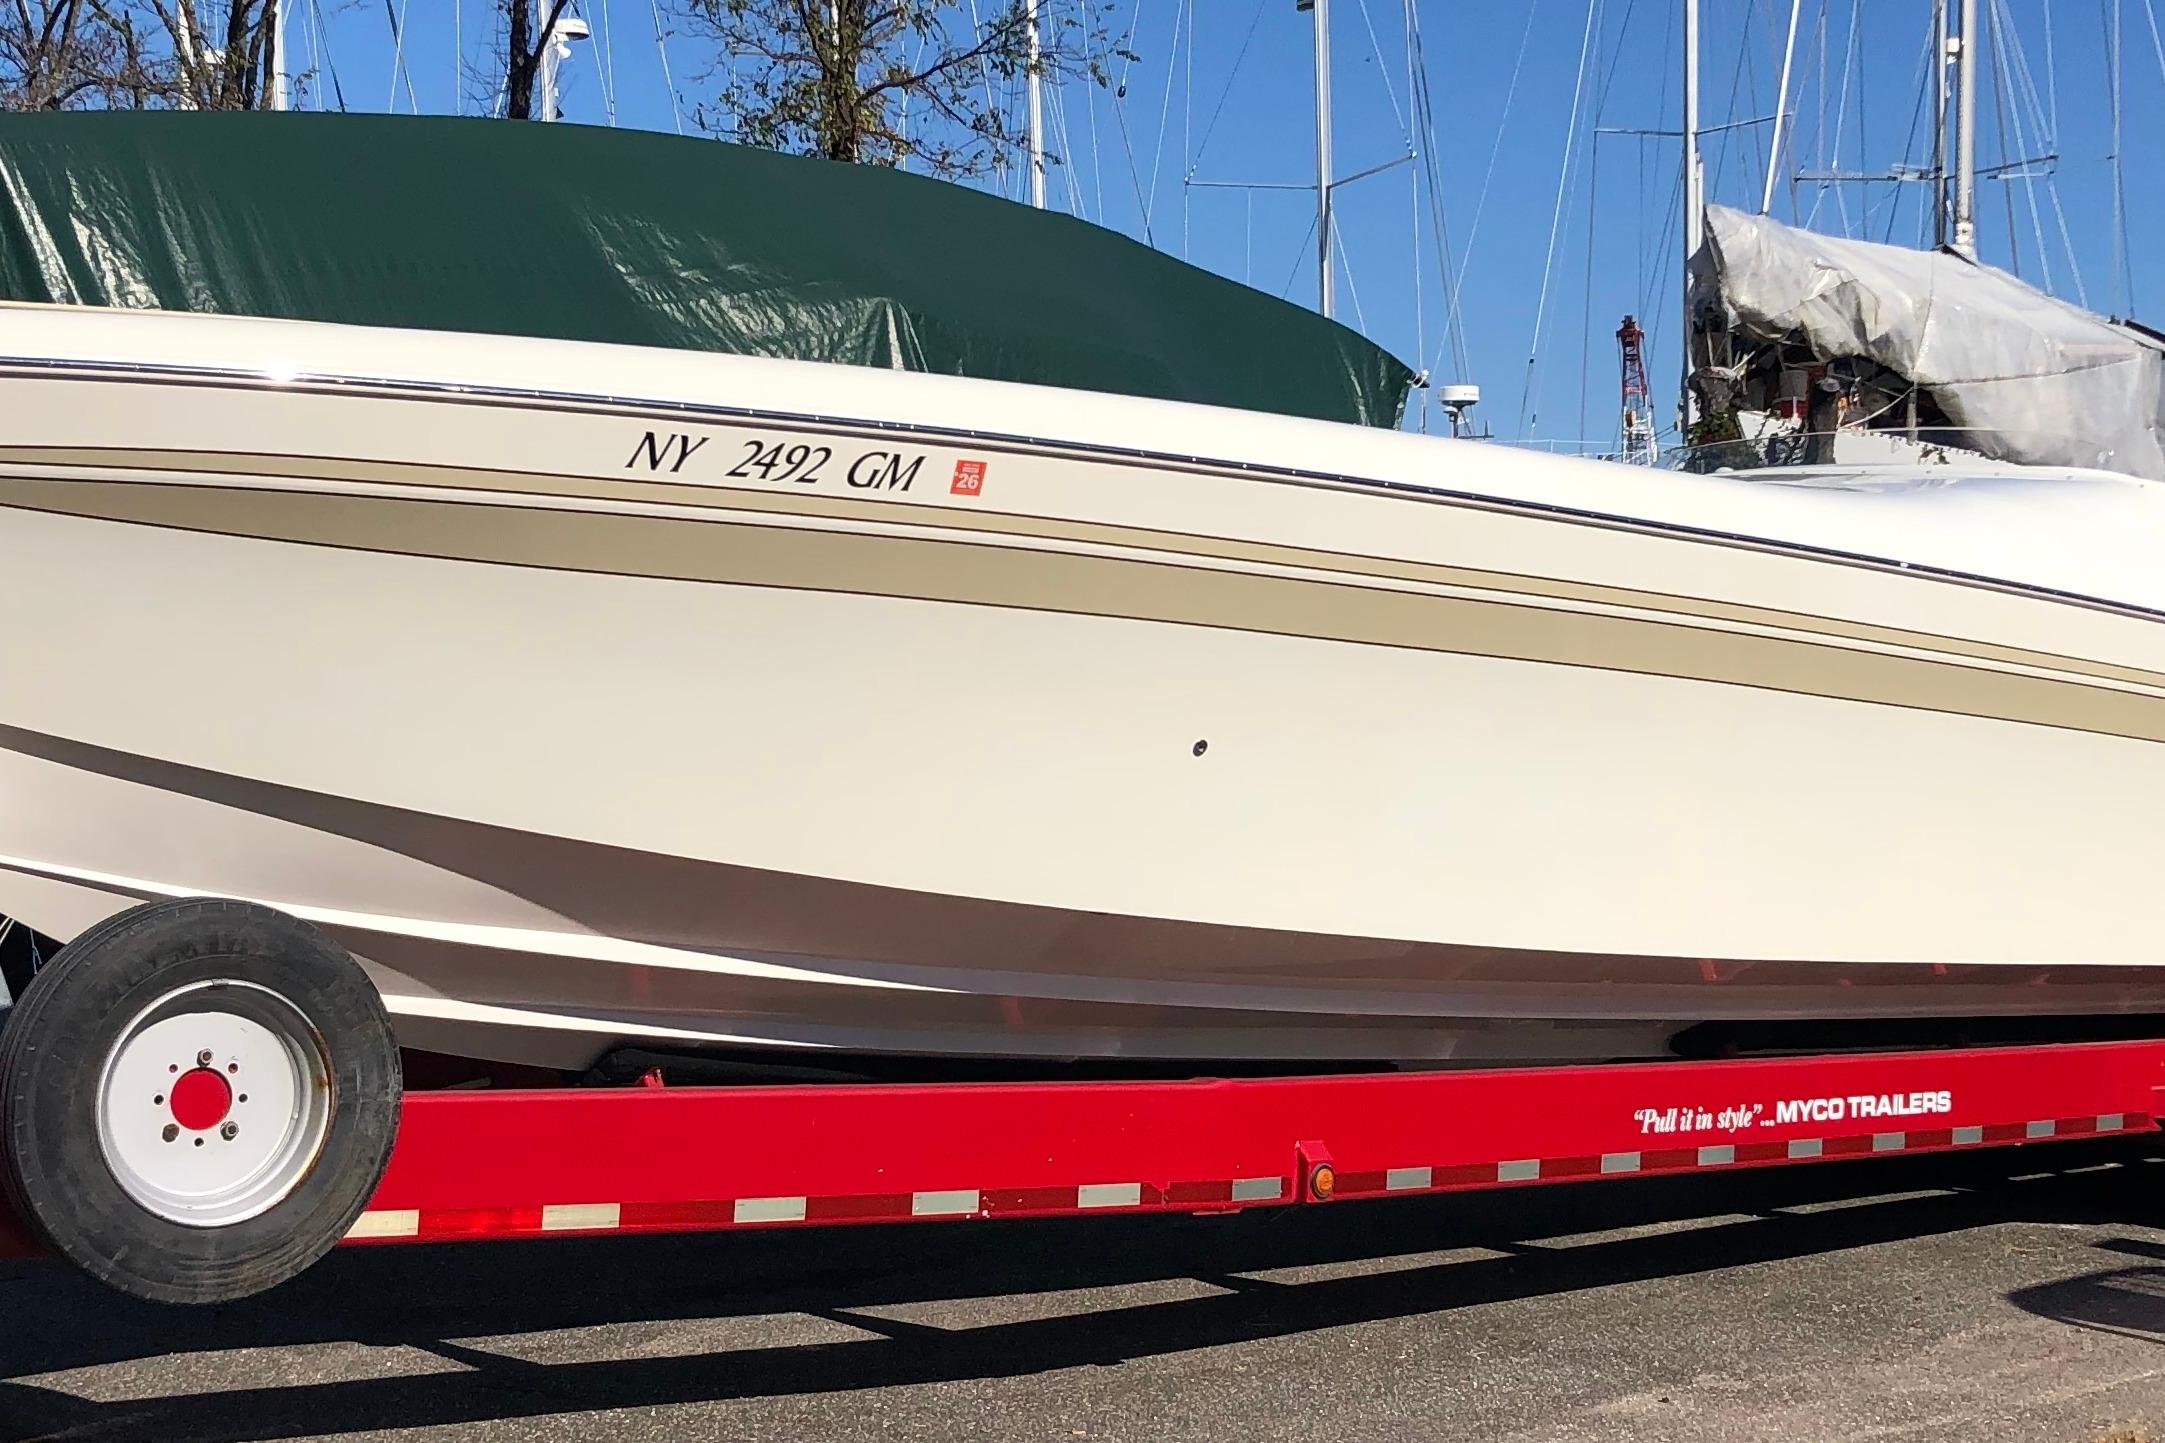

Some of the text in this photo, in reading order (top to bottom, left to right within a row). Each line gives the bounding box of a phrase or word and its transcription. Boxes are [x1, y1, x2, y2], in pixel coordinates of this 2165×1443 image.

[625, 431, 927, 492] NY 2492 GM
[1680, 1107, 1694, 1132] it
[1695, 1105, 1713, 1130] in
[1847, 1090, 1952, 1118] TRAILERS
